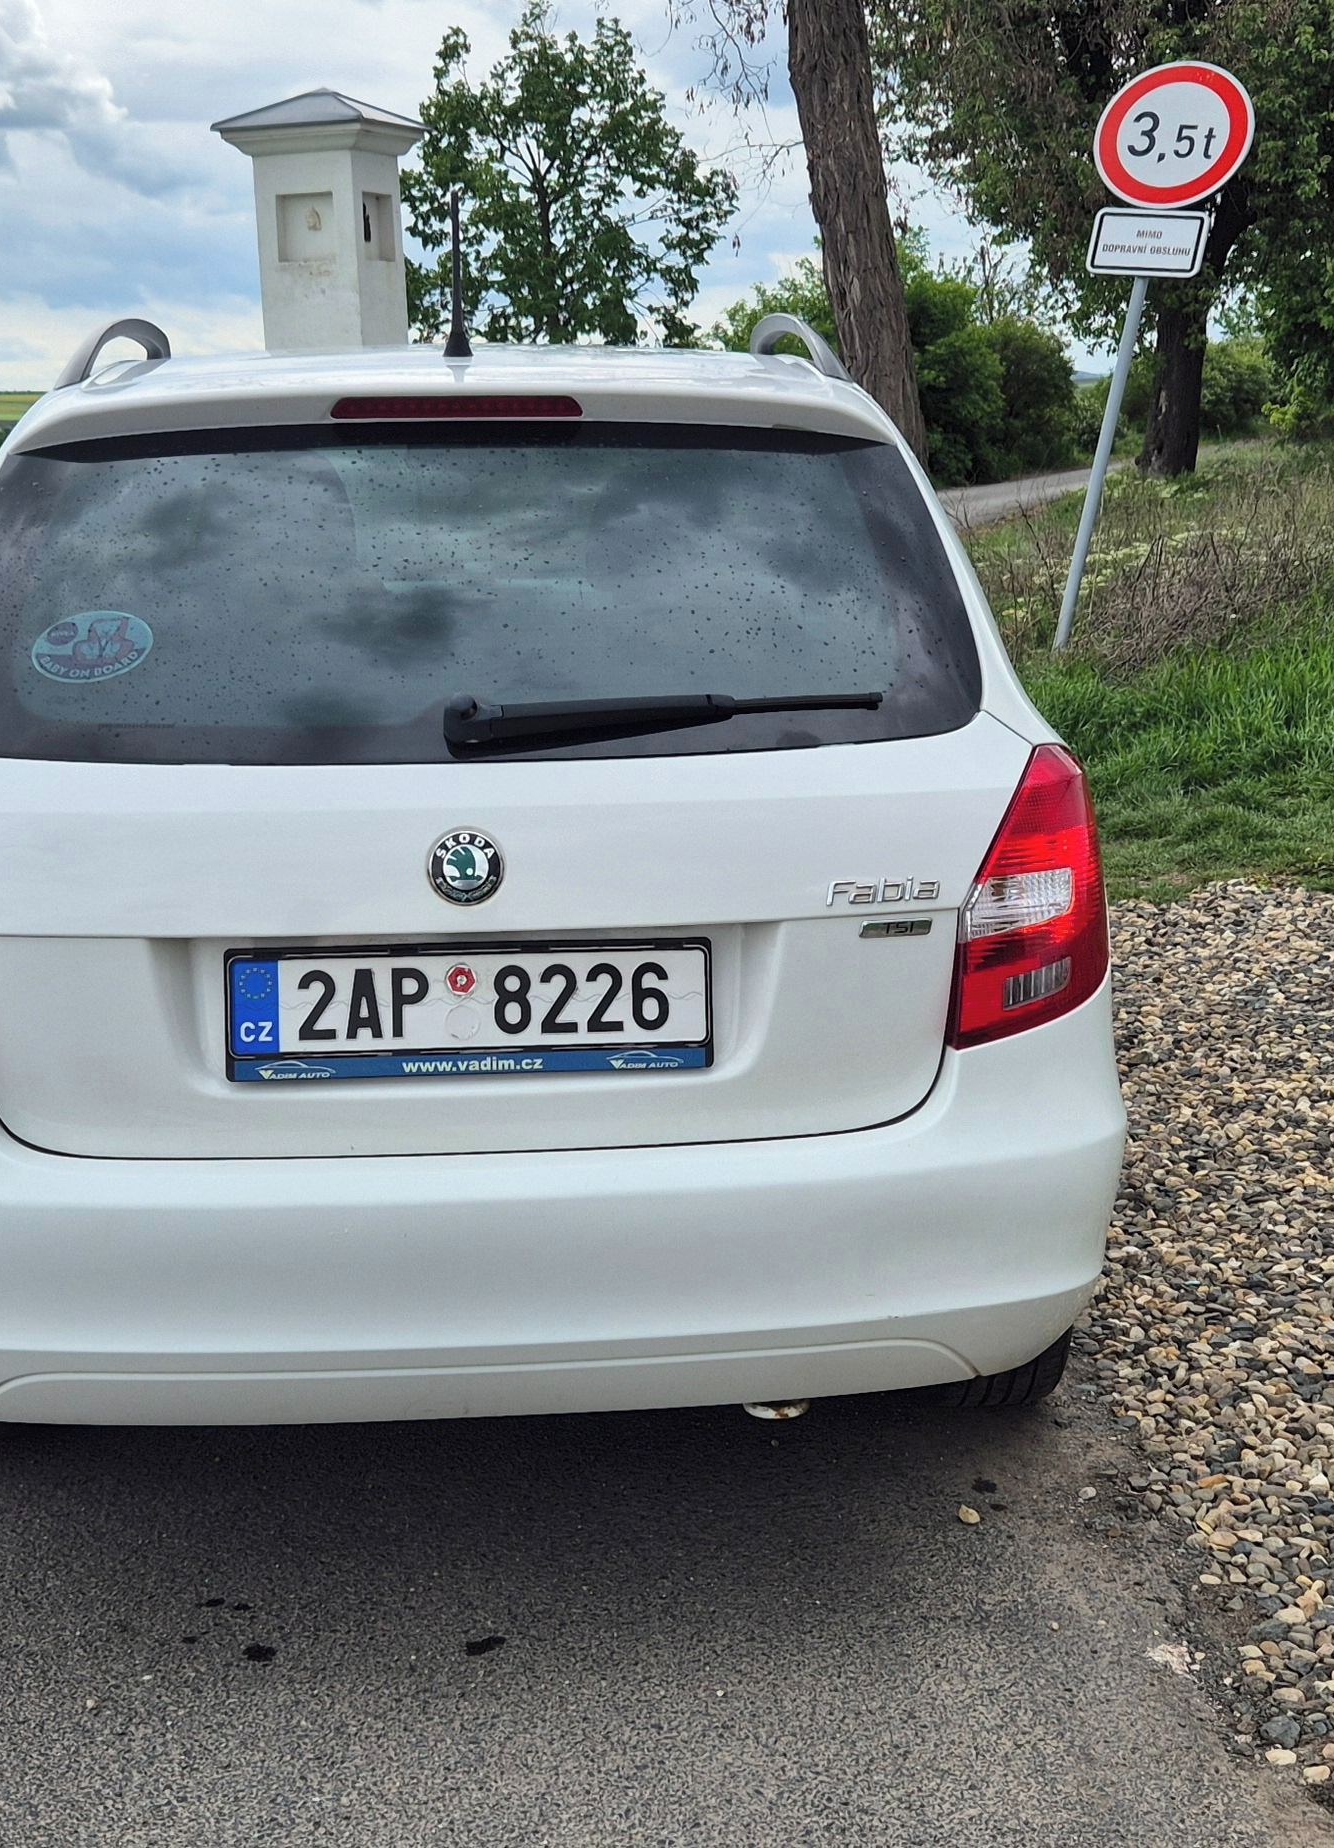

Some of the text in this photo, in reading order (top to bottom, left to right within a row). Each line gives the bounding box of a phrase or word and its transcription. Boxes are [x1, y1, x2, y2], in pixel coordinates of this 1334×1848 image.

[1136, 229, 1163, 240] MIMO
[1102, 243, 1191, 256] DOPRAVNÍ OBSLUHU
[40, 650, 139, 678] BABY ON BOARD
[827, 875, 940, 906] Fabia
[882, 921, 915, 935] TSI
[297, 962, 670, 1041] 2AP 8226
[239, 1020, 273, 1044] CZ
[402, 1056, 543, 1073] www.vadim.cz
[610, 1059, 679, 1069] VADIM AUTO
[258, 1069, 330, 1080] VADIM AUTO
